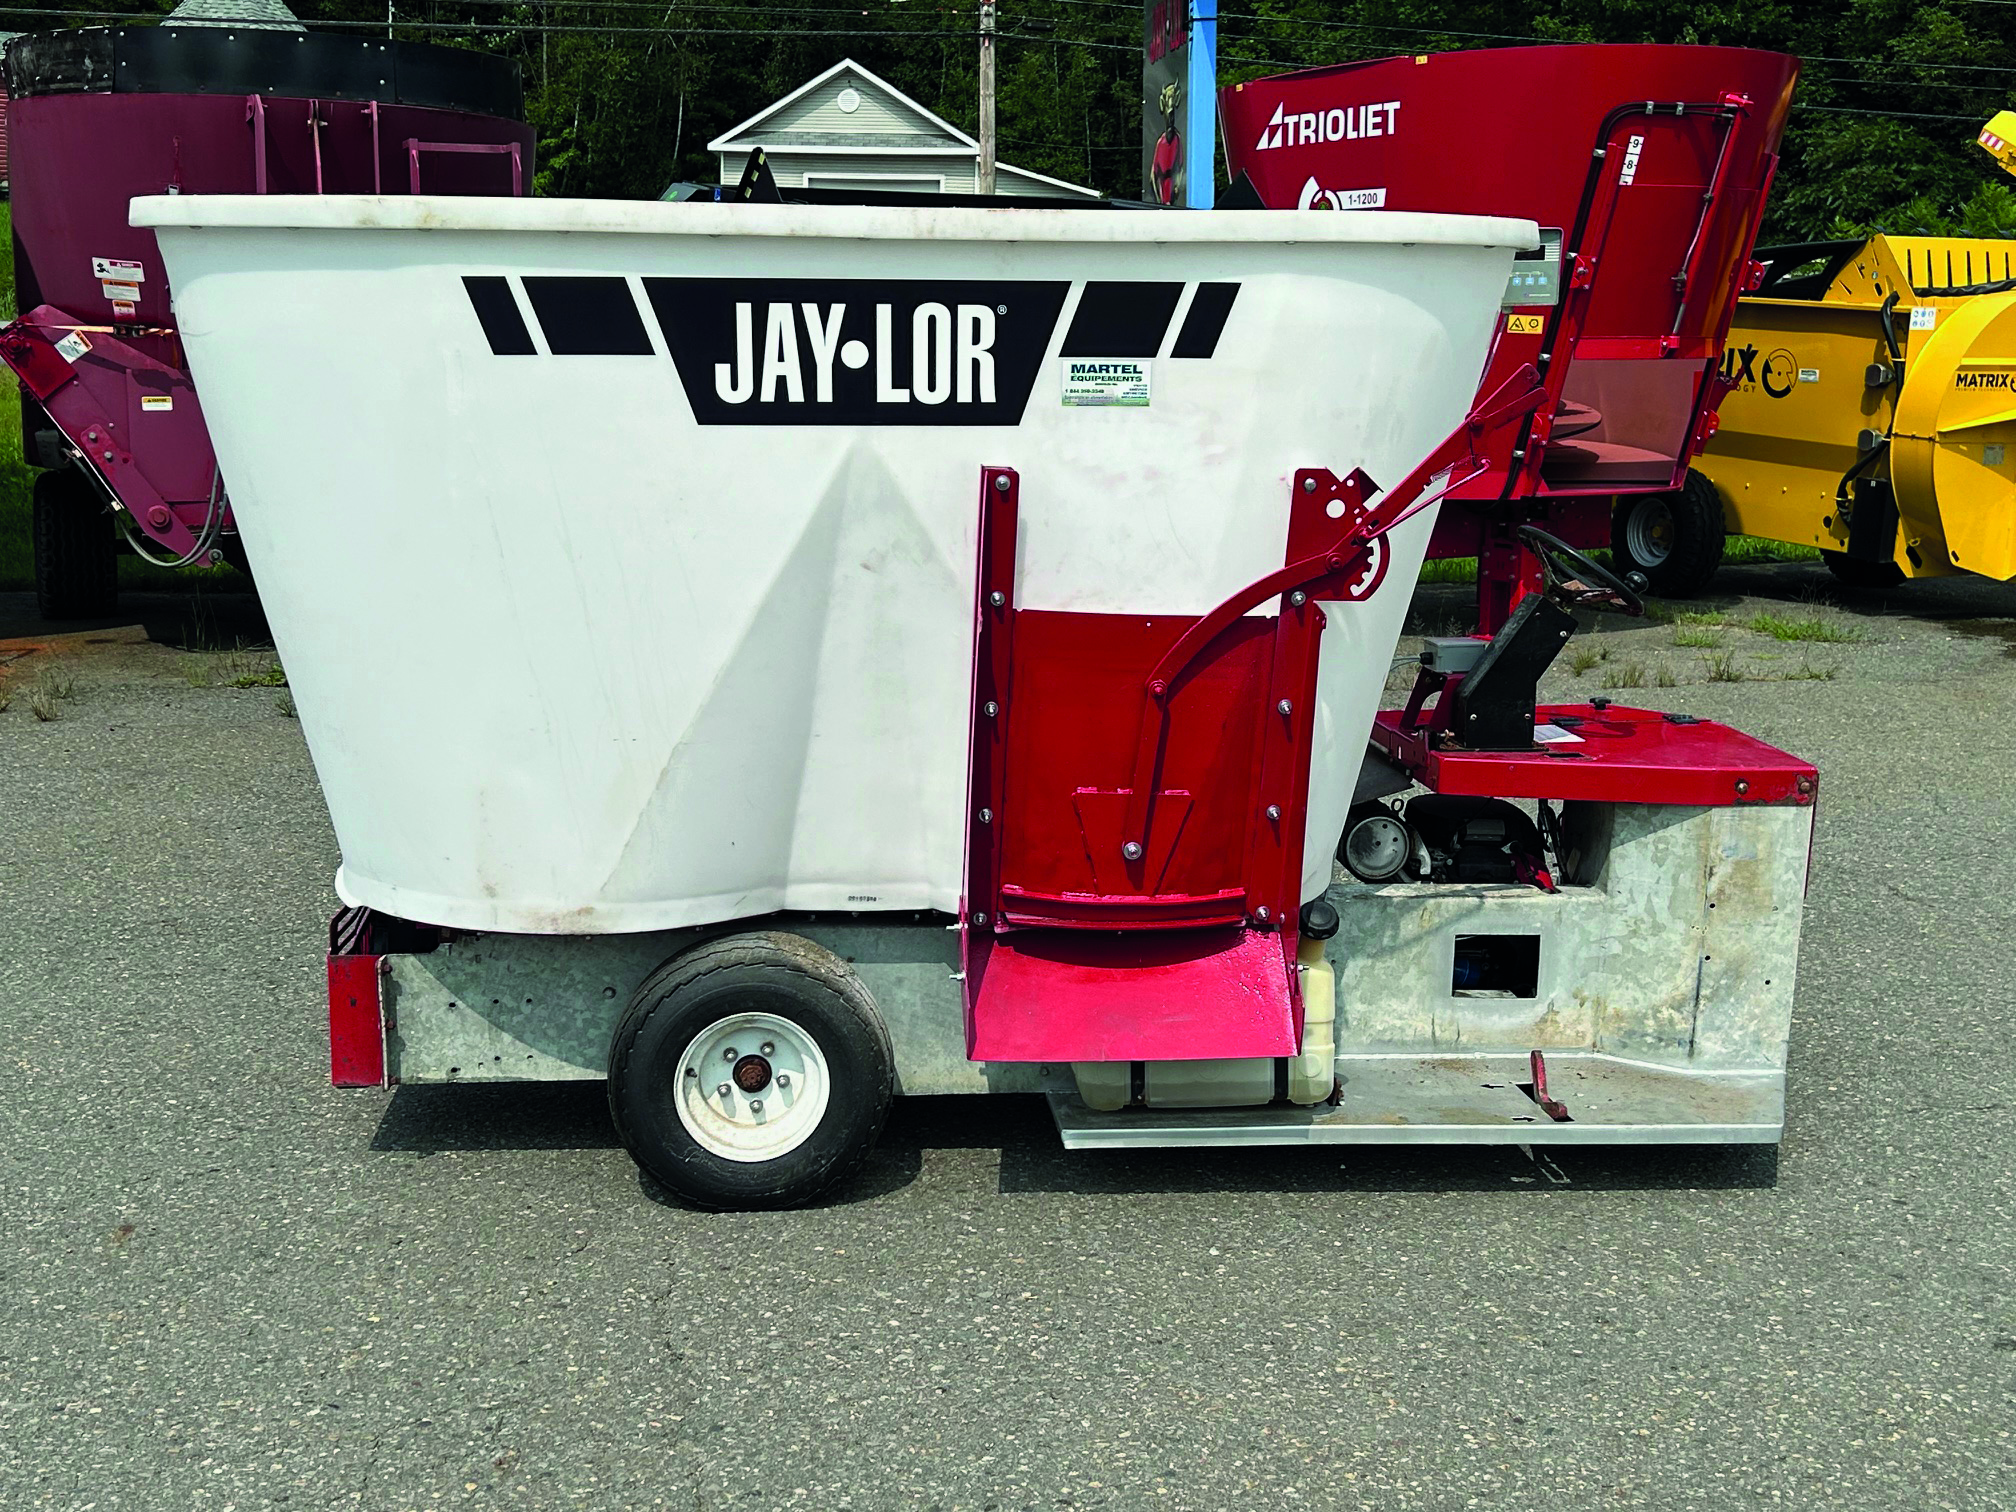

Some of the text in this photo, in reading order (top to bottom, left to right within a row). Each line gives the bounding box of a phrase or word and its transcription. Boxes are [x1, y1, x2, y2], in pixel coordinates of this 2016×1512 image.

[1284, 101, 1401, 147] TRIOLIET
[1632, 139, 1640, 148] 9
[1626, 160, 1634, 169] 8
[1348, 193, 1378, 205] 1-1200
[1070, 364, 1143, 374] MARTEL
[1956, 373, 2010, 388] MATRIX
